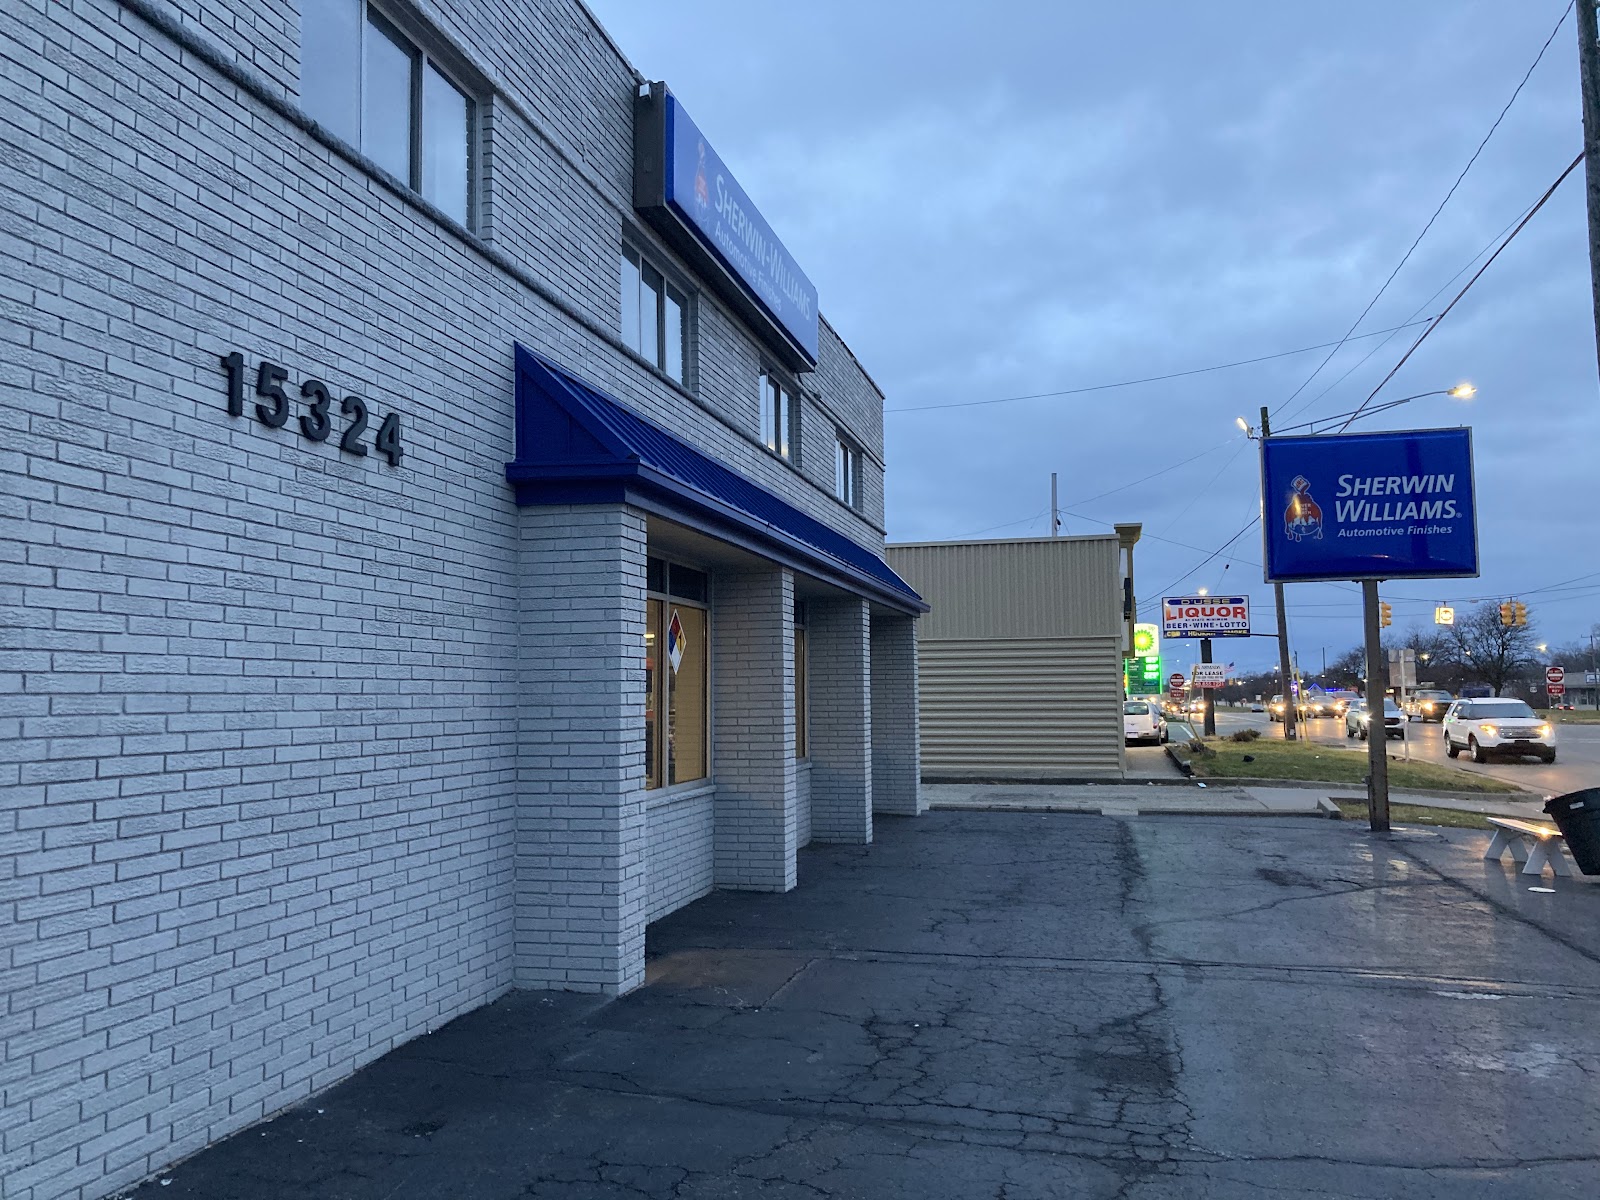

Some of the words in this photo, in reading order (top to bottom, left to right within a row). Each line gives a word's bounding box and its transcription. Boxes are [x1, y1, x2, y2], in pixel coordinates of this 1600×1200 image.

[715, 174, 810, 321] SHERWIN-WILLIAMS
[715, 221, 757, 284] Automotive
[757, 272, 782, 312] Finishes
[221, 351, 403, 467] 15324
[1336, 474, 1455, 497] SHERWIN
[1335, 500, 1457, 523] WILLIAMS
[1337, 526, 1404, 538] Automotive
[1407, 525, 1452, 535] Finishes
[1166, 606, 1246, 621] LIQUOR
